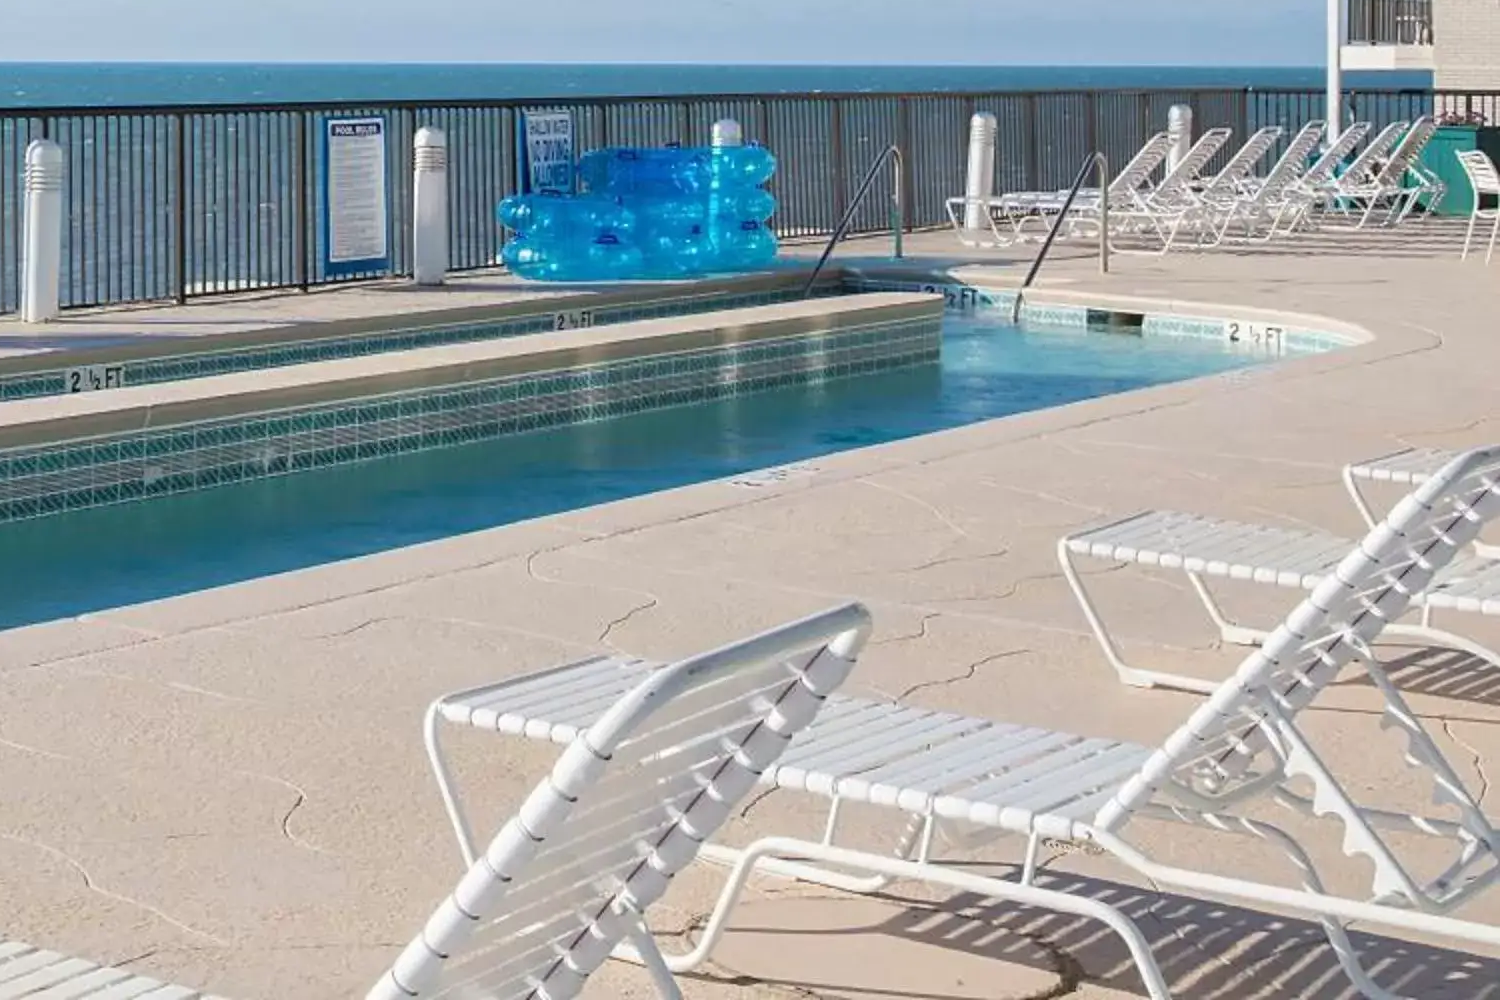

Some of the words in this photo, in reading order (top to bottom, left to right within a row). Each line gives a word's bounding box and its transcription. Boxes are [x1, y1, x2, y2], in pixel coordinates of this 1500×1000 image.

[557, 314, 565, 330] 2
[1230, 323, 1240, 342] 2
[1265, 327, 1282, 348] FT
[71, 371, 81, 392] 2
[105, 367, 122, 389] FT
